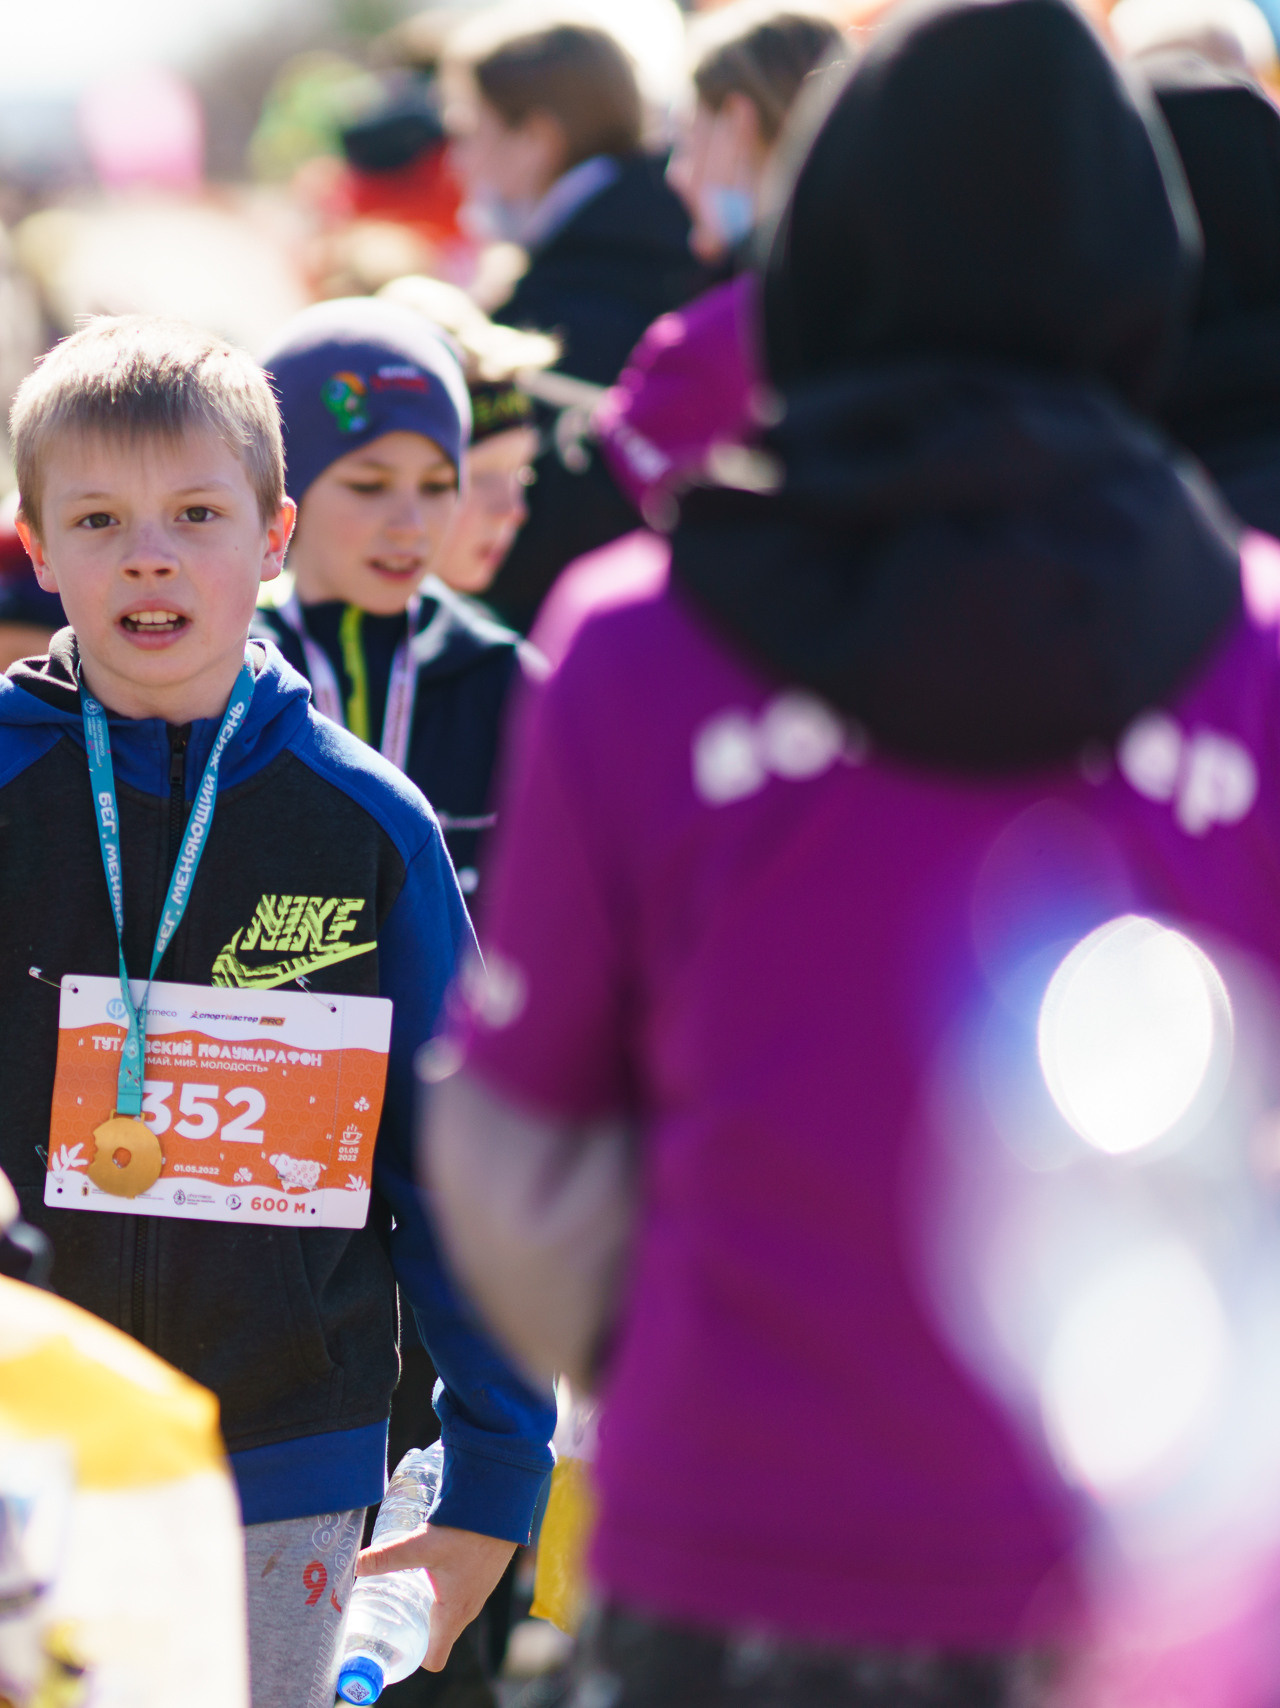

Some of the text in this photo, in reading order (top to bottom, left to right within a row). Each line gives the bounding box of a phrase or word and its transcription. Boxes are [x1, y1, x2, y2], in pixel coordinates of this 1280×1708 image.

[98, 792, 117, 839] БЕГ.
[171, 774, 216, 905] МЕНЯЮЩИЙ
[239, 893, 366, 953] NIKE
[261, 1017, 284, 1026] PRO
[198, 1043, 322, 1068] ПОЛУМАРАФОН
[174, 1060, 199, 1069] МИР.
[200, 1061, 269, 1073] МОЛОДОСТЬ»
[141, 1080, 267, 1144] 352
[337, 1154, 358, 1162] 2022
[338, 1146, 360, 1154] 01.05
[173, 1164, 220, 1175] 01.05.2022
[250, 1196, 289, 1213] 600
